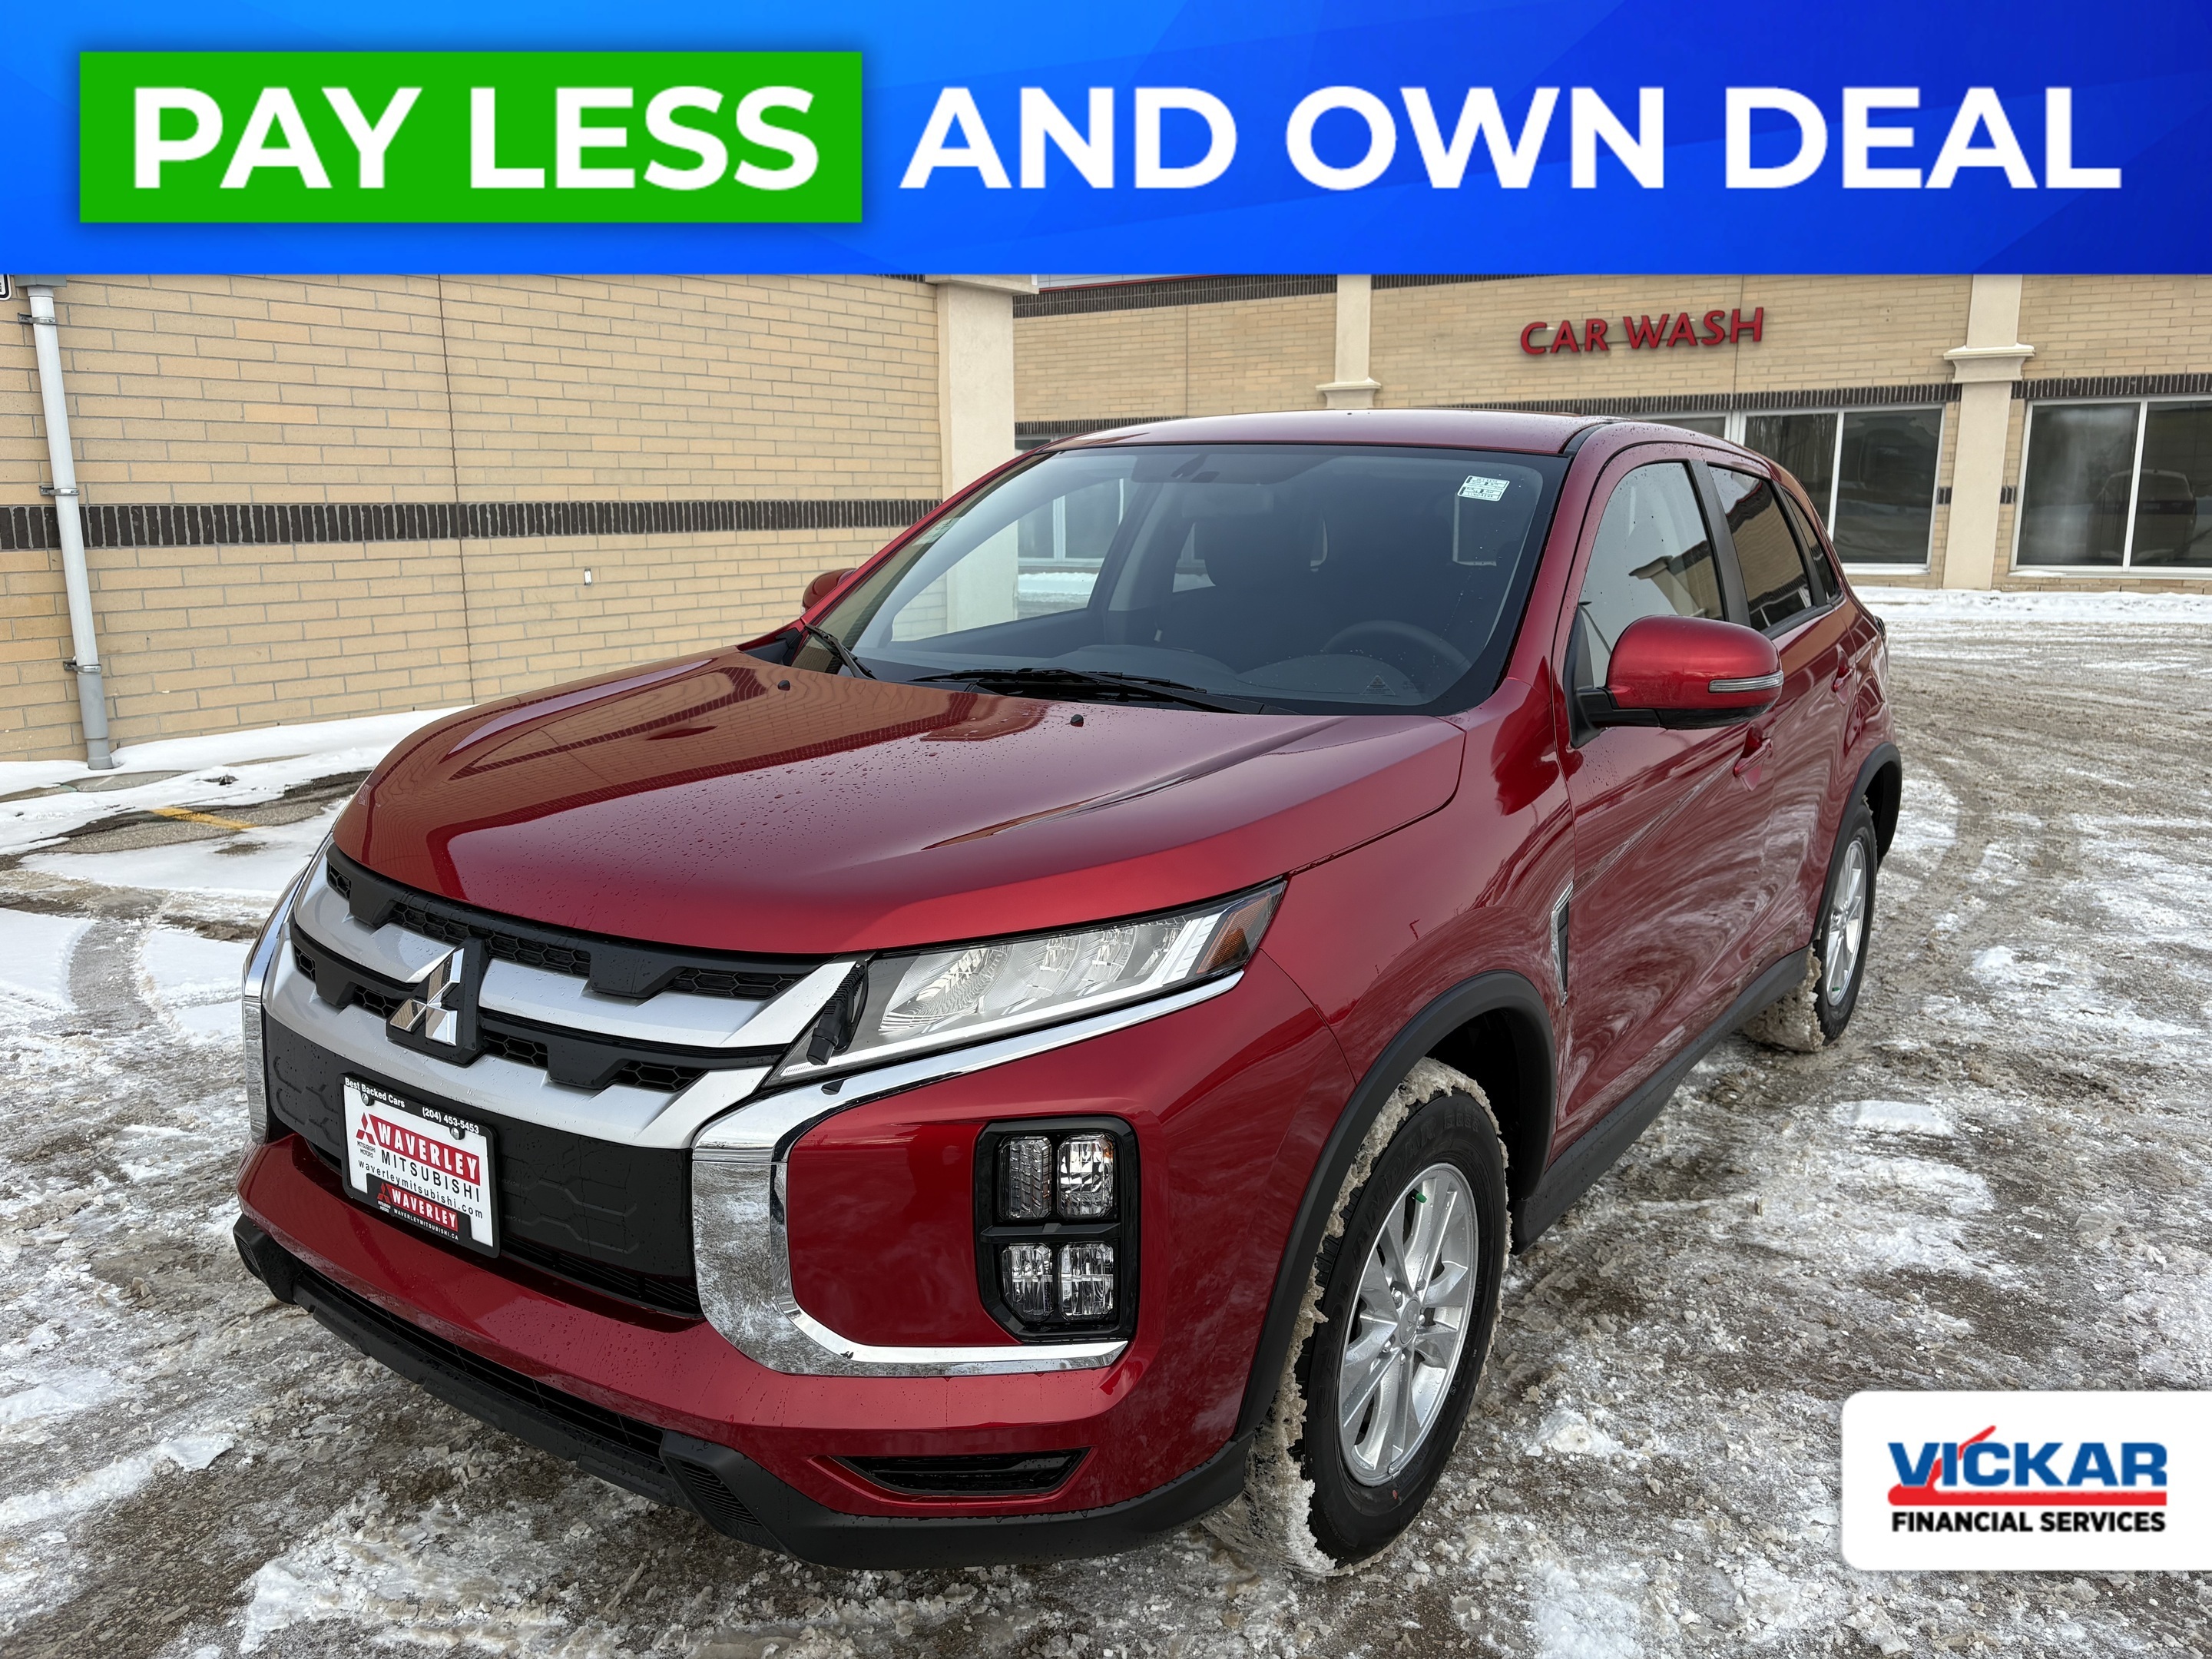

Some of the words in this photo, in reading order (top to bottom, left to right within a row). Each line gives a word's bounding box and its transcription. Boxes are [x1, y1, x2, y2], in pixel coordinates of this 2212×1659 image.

[1520, 319, 1610, 355] CAR
[1622, 307, 1764, 349] WASH
[345, 1077, 360, 1091] Best
[361, 1083, 387, 1101] Backed
[388, 1095, 406, 1108] Cars
[422, 1107, 442, 1123] (204)
[443, 1116, 479, 1134] 453-5453
[377, 1121, 478, 1181] WAVERLEY
[358, 1159, 483, 1219] waverleymitsubishi.com
[381, 1149, 480, 1202] MITSUBISHI
[391, 1188, 456, 1228] WAVERLEY
[393, 1208, 459, 1240] WAVERLEYMITSUBISHI.CA
